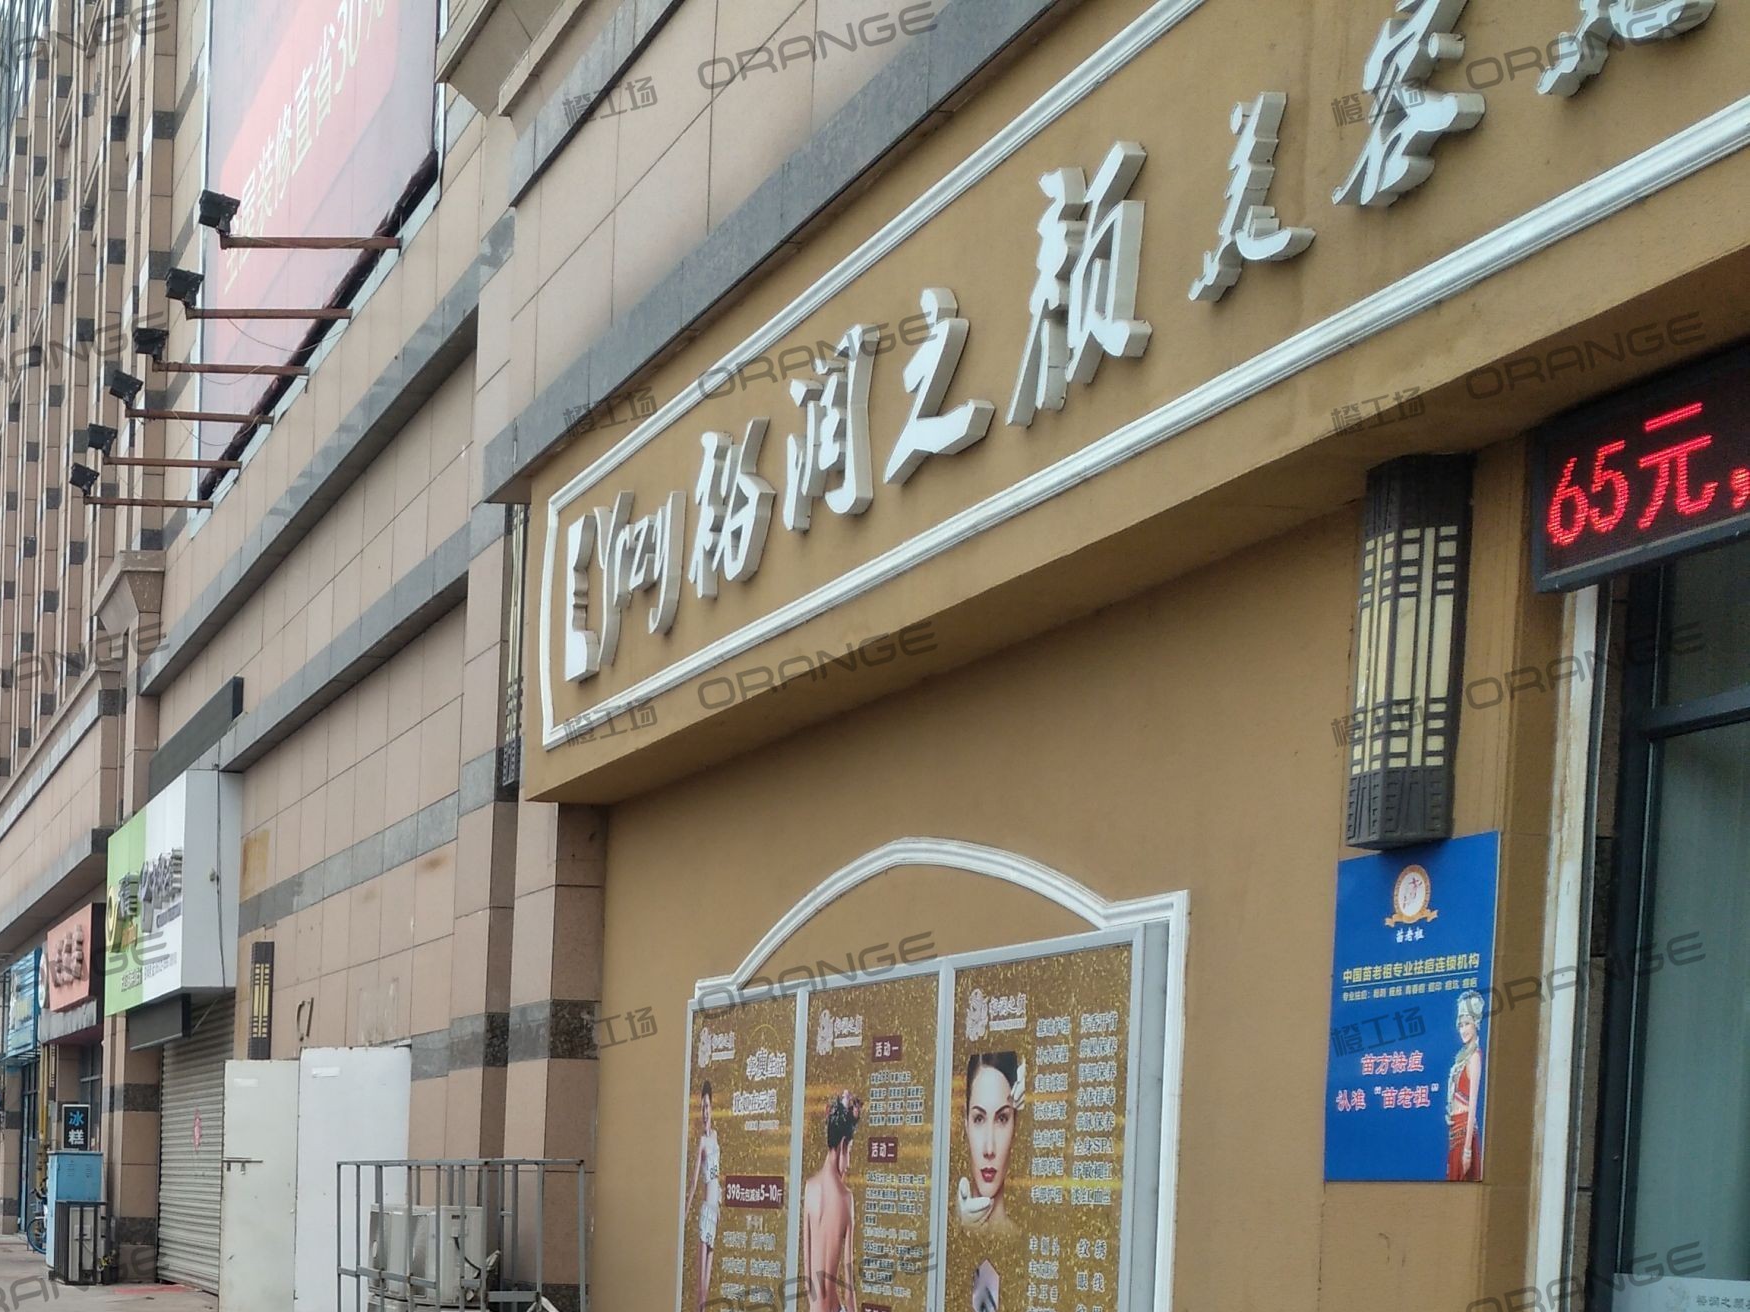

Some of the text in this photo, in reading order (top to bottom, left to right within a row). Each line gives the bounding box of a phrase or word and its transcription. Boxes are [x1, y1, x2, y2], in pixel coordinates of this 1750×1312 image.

[1396, 927, 1424, 943] 苗老祖
[1342, 952, 1480, 984] 中国苗老祖专业祛痘连锁机构
[875, 1042, 899, 1057] 活动一
[747, 1047, 786, 1080] 享瘦生活
[1361, 1050, 1424, 1075] 苗方祛痘
[1336, 1088, 1366, 1112] 认准
[68, 1110, 85, 1146] 冰糕
[871, 1143, 895, 1157] 活动二
[1074, 1136, 1114, 1155] 全身SPA
